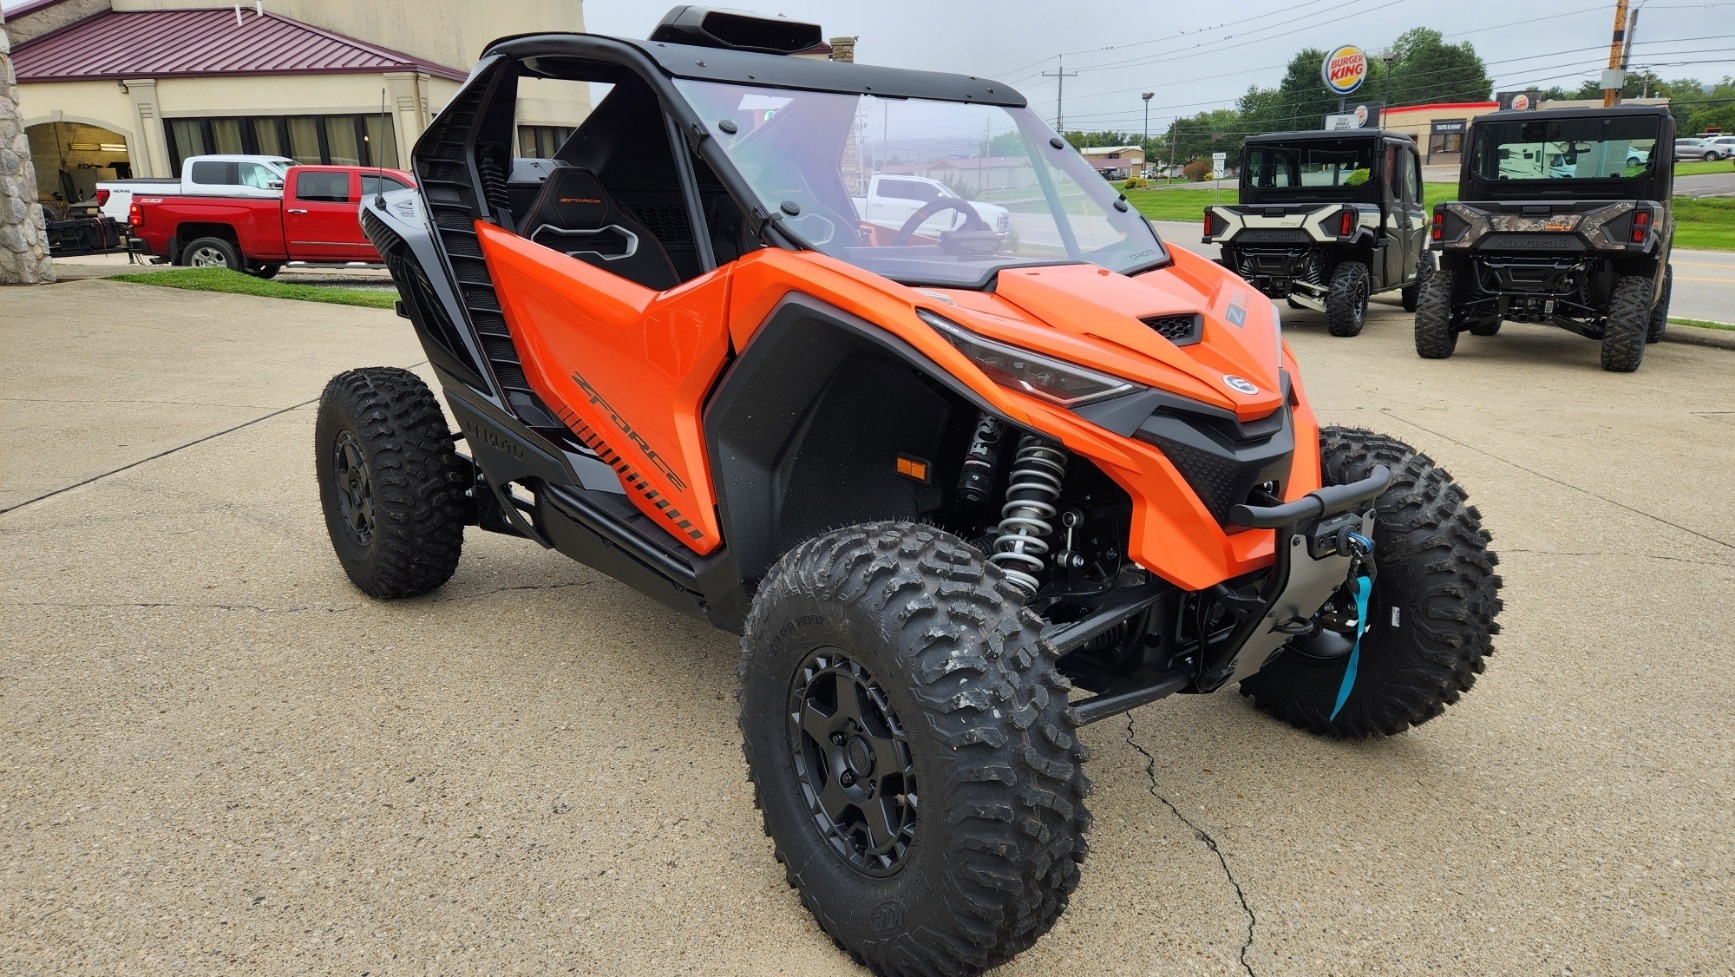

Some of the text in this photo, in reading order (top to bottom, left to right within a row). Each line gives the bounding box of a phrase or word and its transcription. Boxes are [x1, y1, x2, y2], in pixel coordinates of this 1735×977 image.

[1331, 54, 1363, 69] BURGER
[1330, 64, 1363, 81] KING
[1250, 232, 1300, 242] Kawasaki
[1496, 236, 1570, 249] Kawasaki
[572, 371, 687, 492] ZFORCE
[970, 412, 1001, 456] FOX
[796, 614, 827, 627] HOOK
